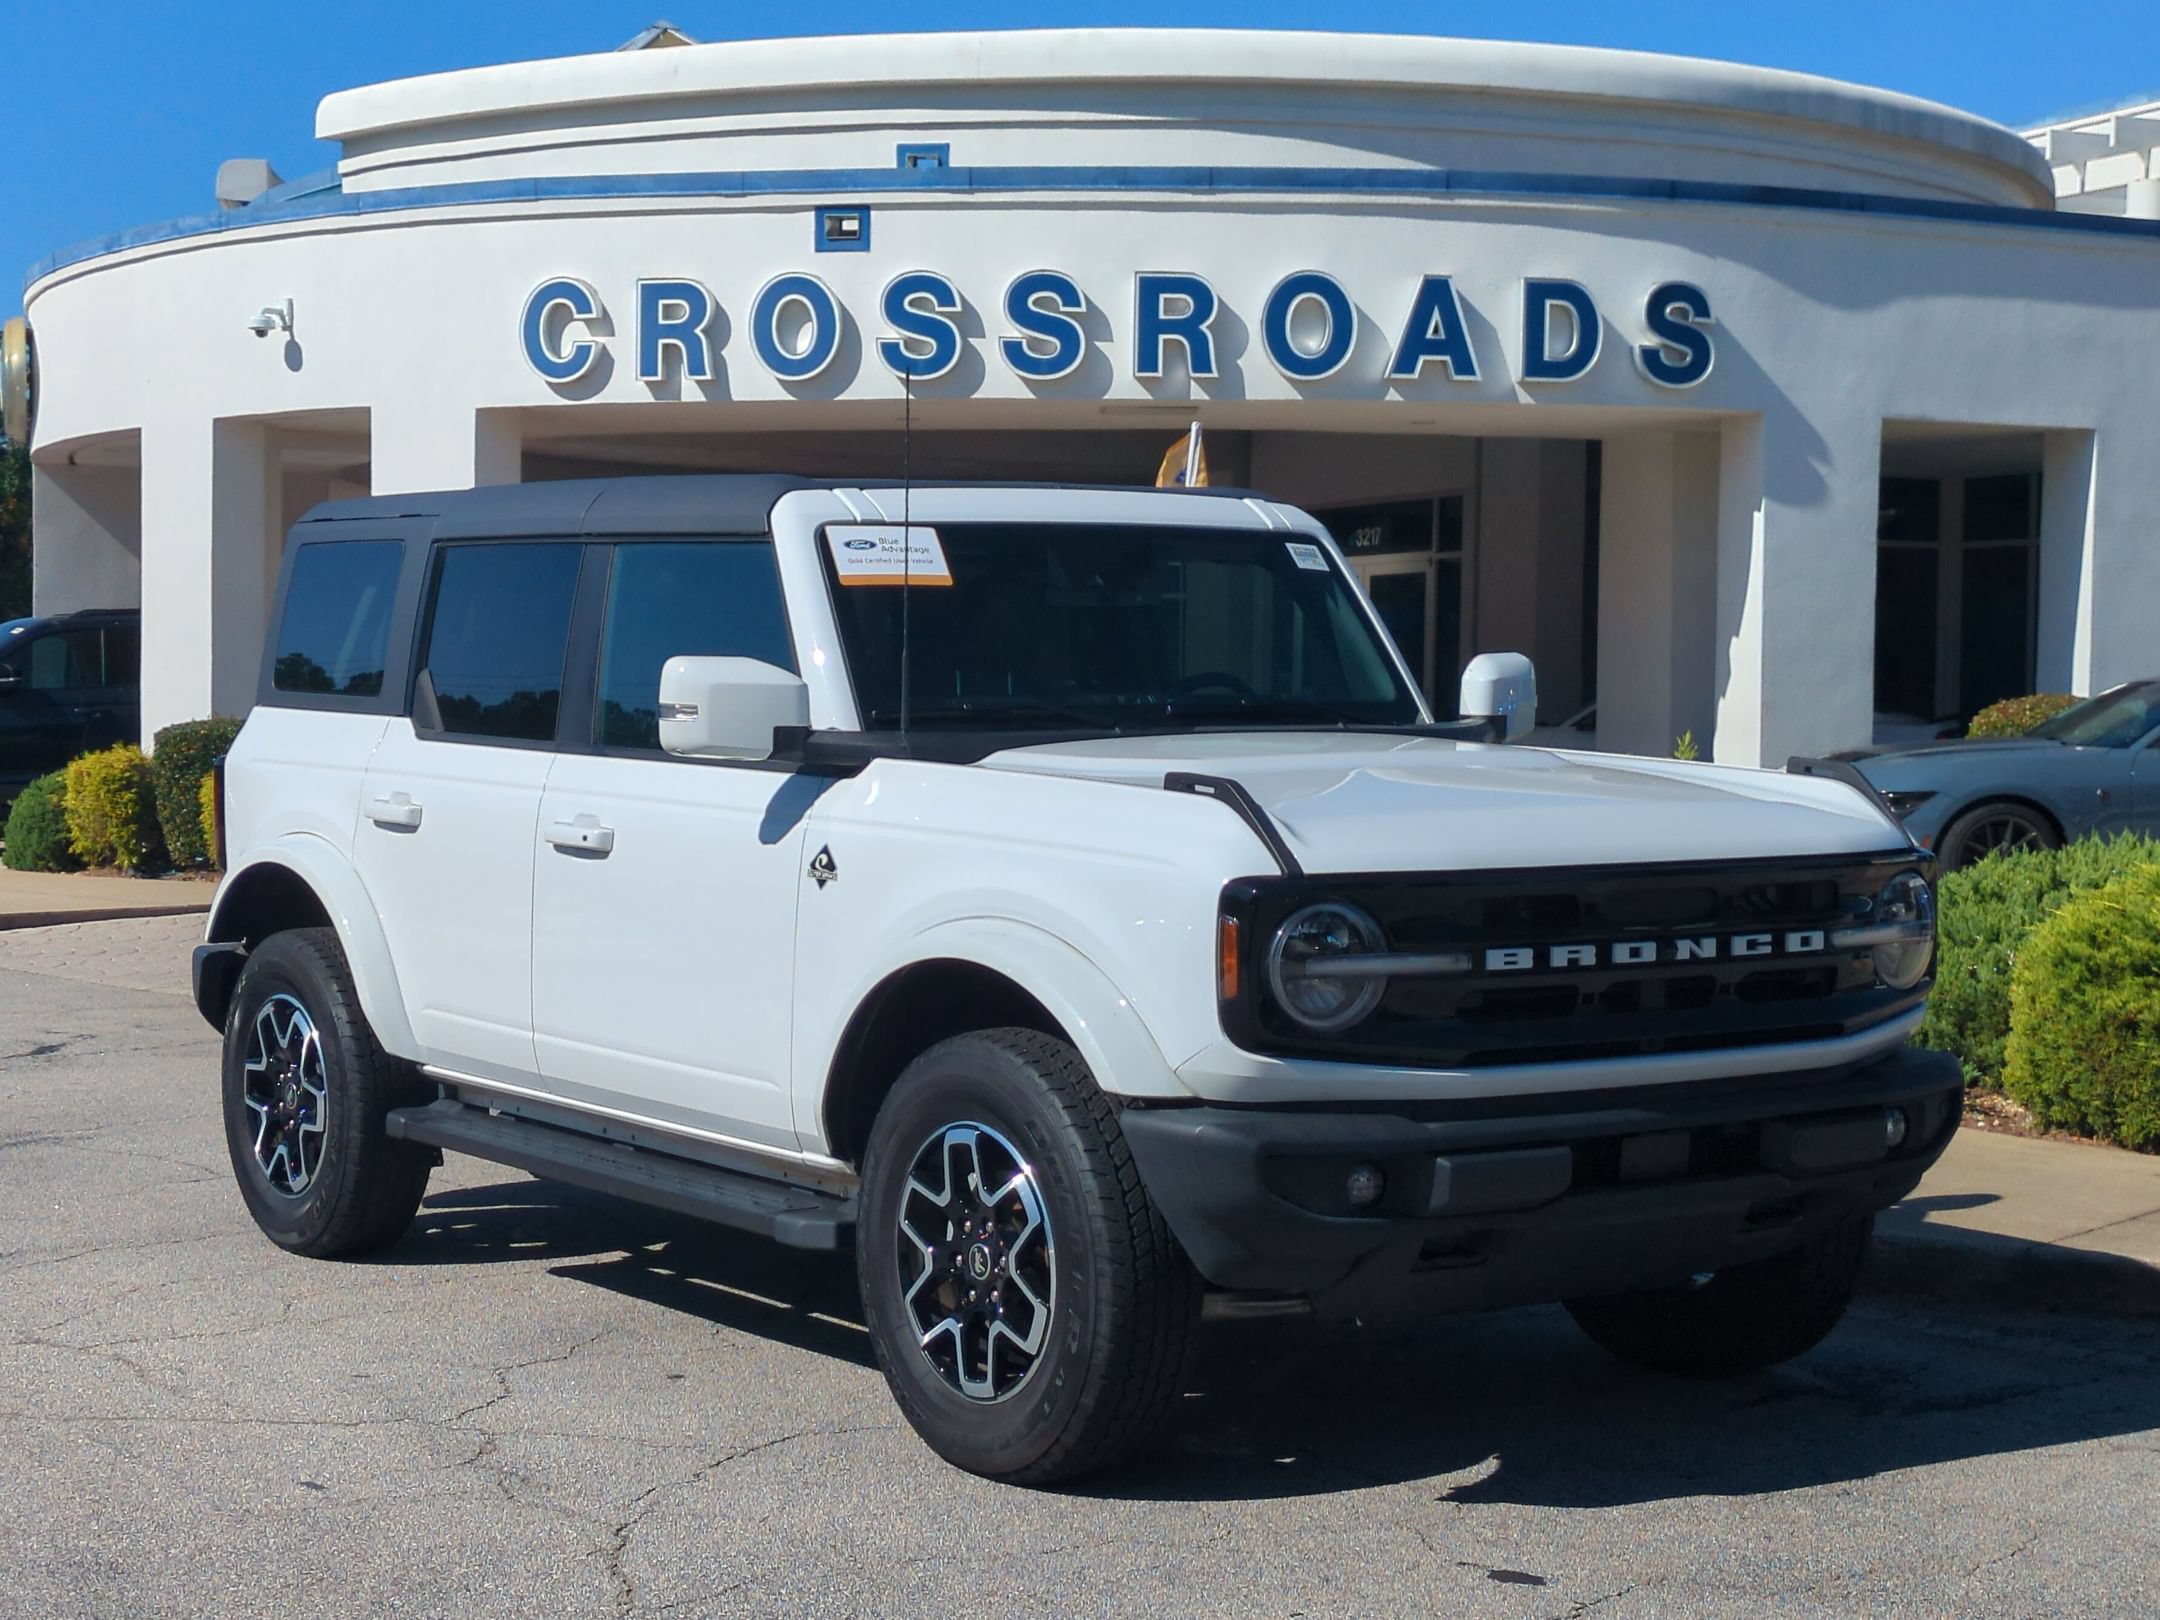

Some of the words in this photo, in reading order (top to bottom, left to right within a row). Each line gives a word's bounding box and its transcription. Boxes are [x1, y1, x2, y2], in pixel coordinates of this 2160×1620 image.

[520, 270, 1716, 388] CROSSROADS
[879, 537, 899, 545] Blue
[1355, 527, 1382, 547] 3217
[1485, 930, 1825, 971] BRONCO
